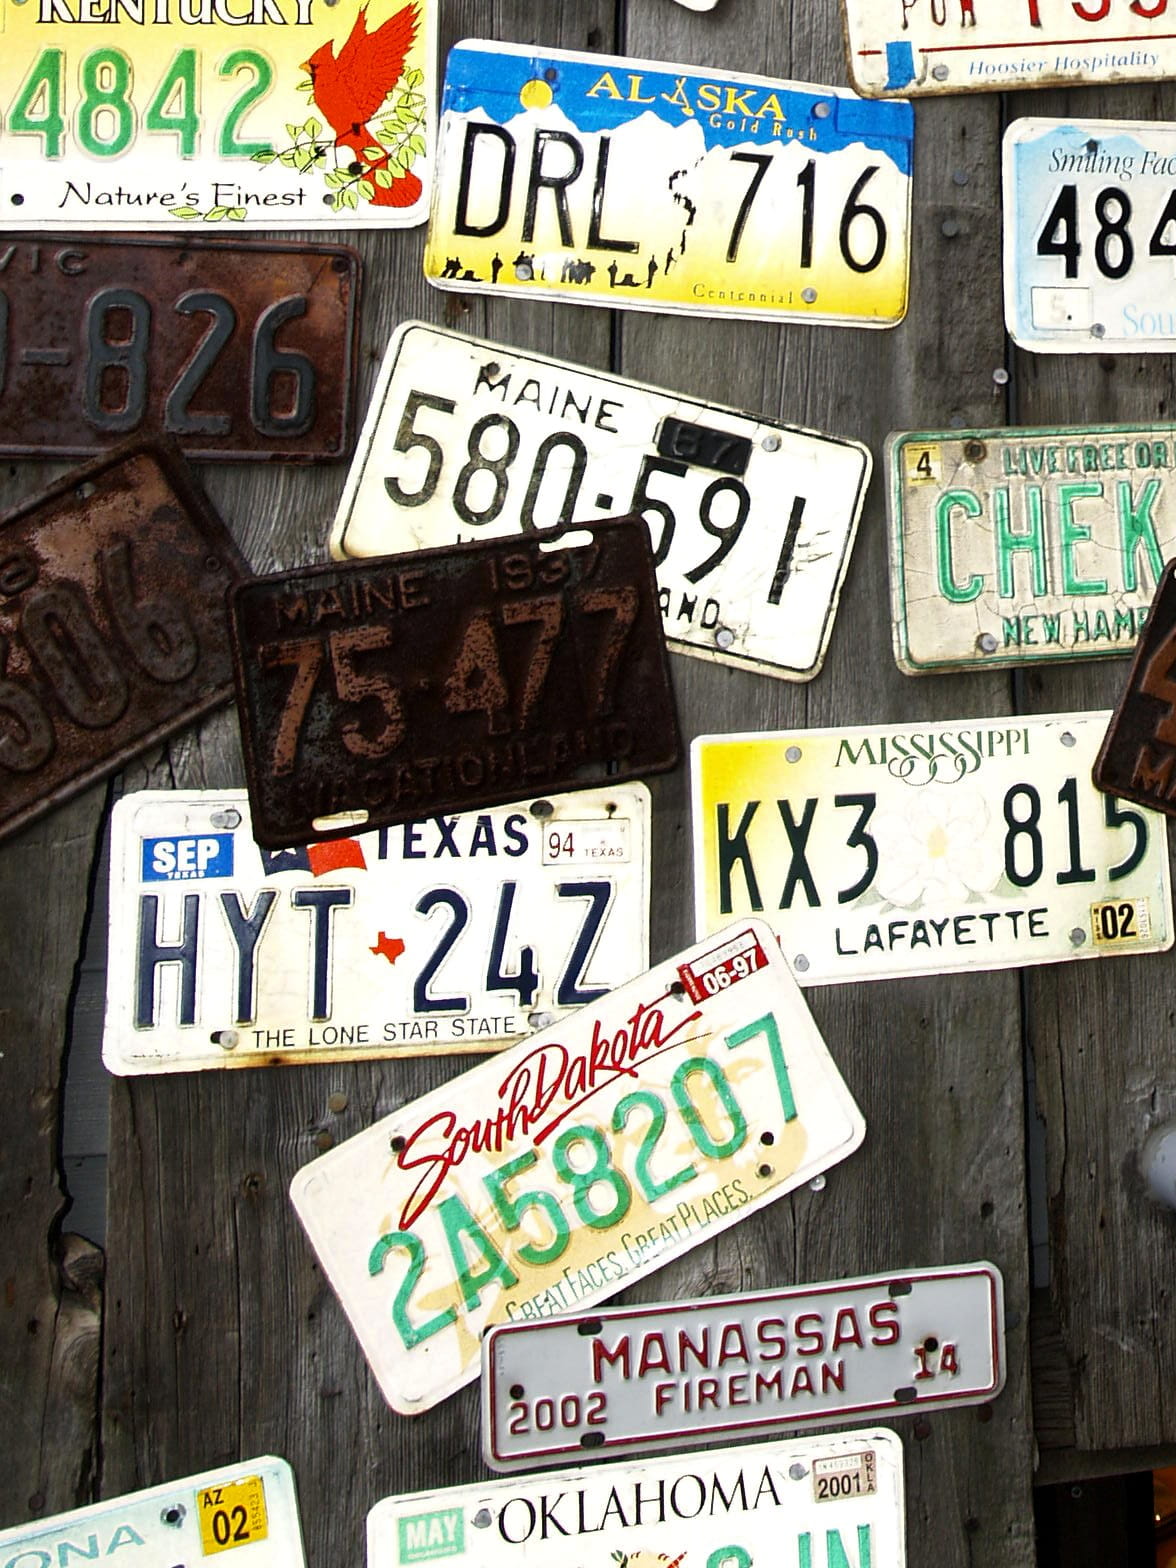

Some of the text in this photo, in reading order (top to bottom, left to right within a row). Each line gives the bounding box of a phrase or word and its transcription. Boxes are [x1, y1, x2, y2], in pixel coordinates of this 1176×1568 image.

[968, 49, 1161, 78] Hoosier Hospitality
[6, 45, 275, 161] 4842
[1047, 145, 1135, 179] Smiling
[57, 179, 308, 209] Nature's Finest
[452, 121, 888, 274] DRL 716
[692, 283, 795, 306] Centennial
[473, 366, 625, 435] MAINE
[1001, 611, 1061, 648] NEW
[833, 727, 1032, 788] MISSISSIPPI
[151, 839, 221, 875] SEP
[376, 814, 531, 862] TEXAS
[547, 830, 576, 860] 94
[716, 792, 880, 916] KX3
[833, 907, 1050, 957] LAFAYETTE
[1099, 900, 1135, 941] 02
[134, 887, 353, 1031] HYT
[252, 1014, 518, 1051] THE LONE STAR STATE
[368, 1011, 799, 1351] 2A58207
[590, 1300, 902, 1385] MANASSAS
[509, 1362, 848, 1437] 2002 FIREMAN
[498, 1462, 782, 1545] OKLAHOMA
[817, 1471, 862, 1501] 2001
[212, 1505, 250, 1547] 02
